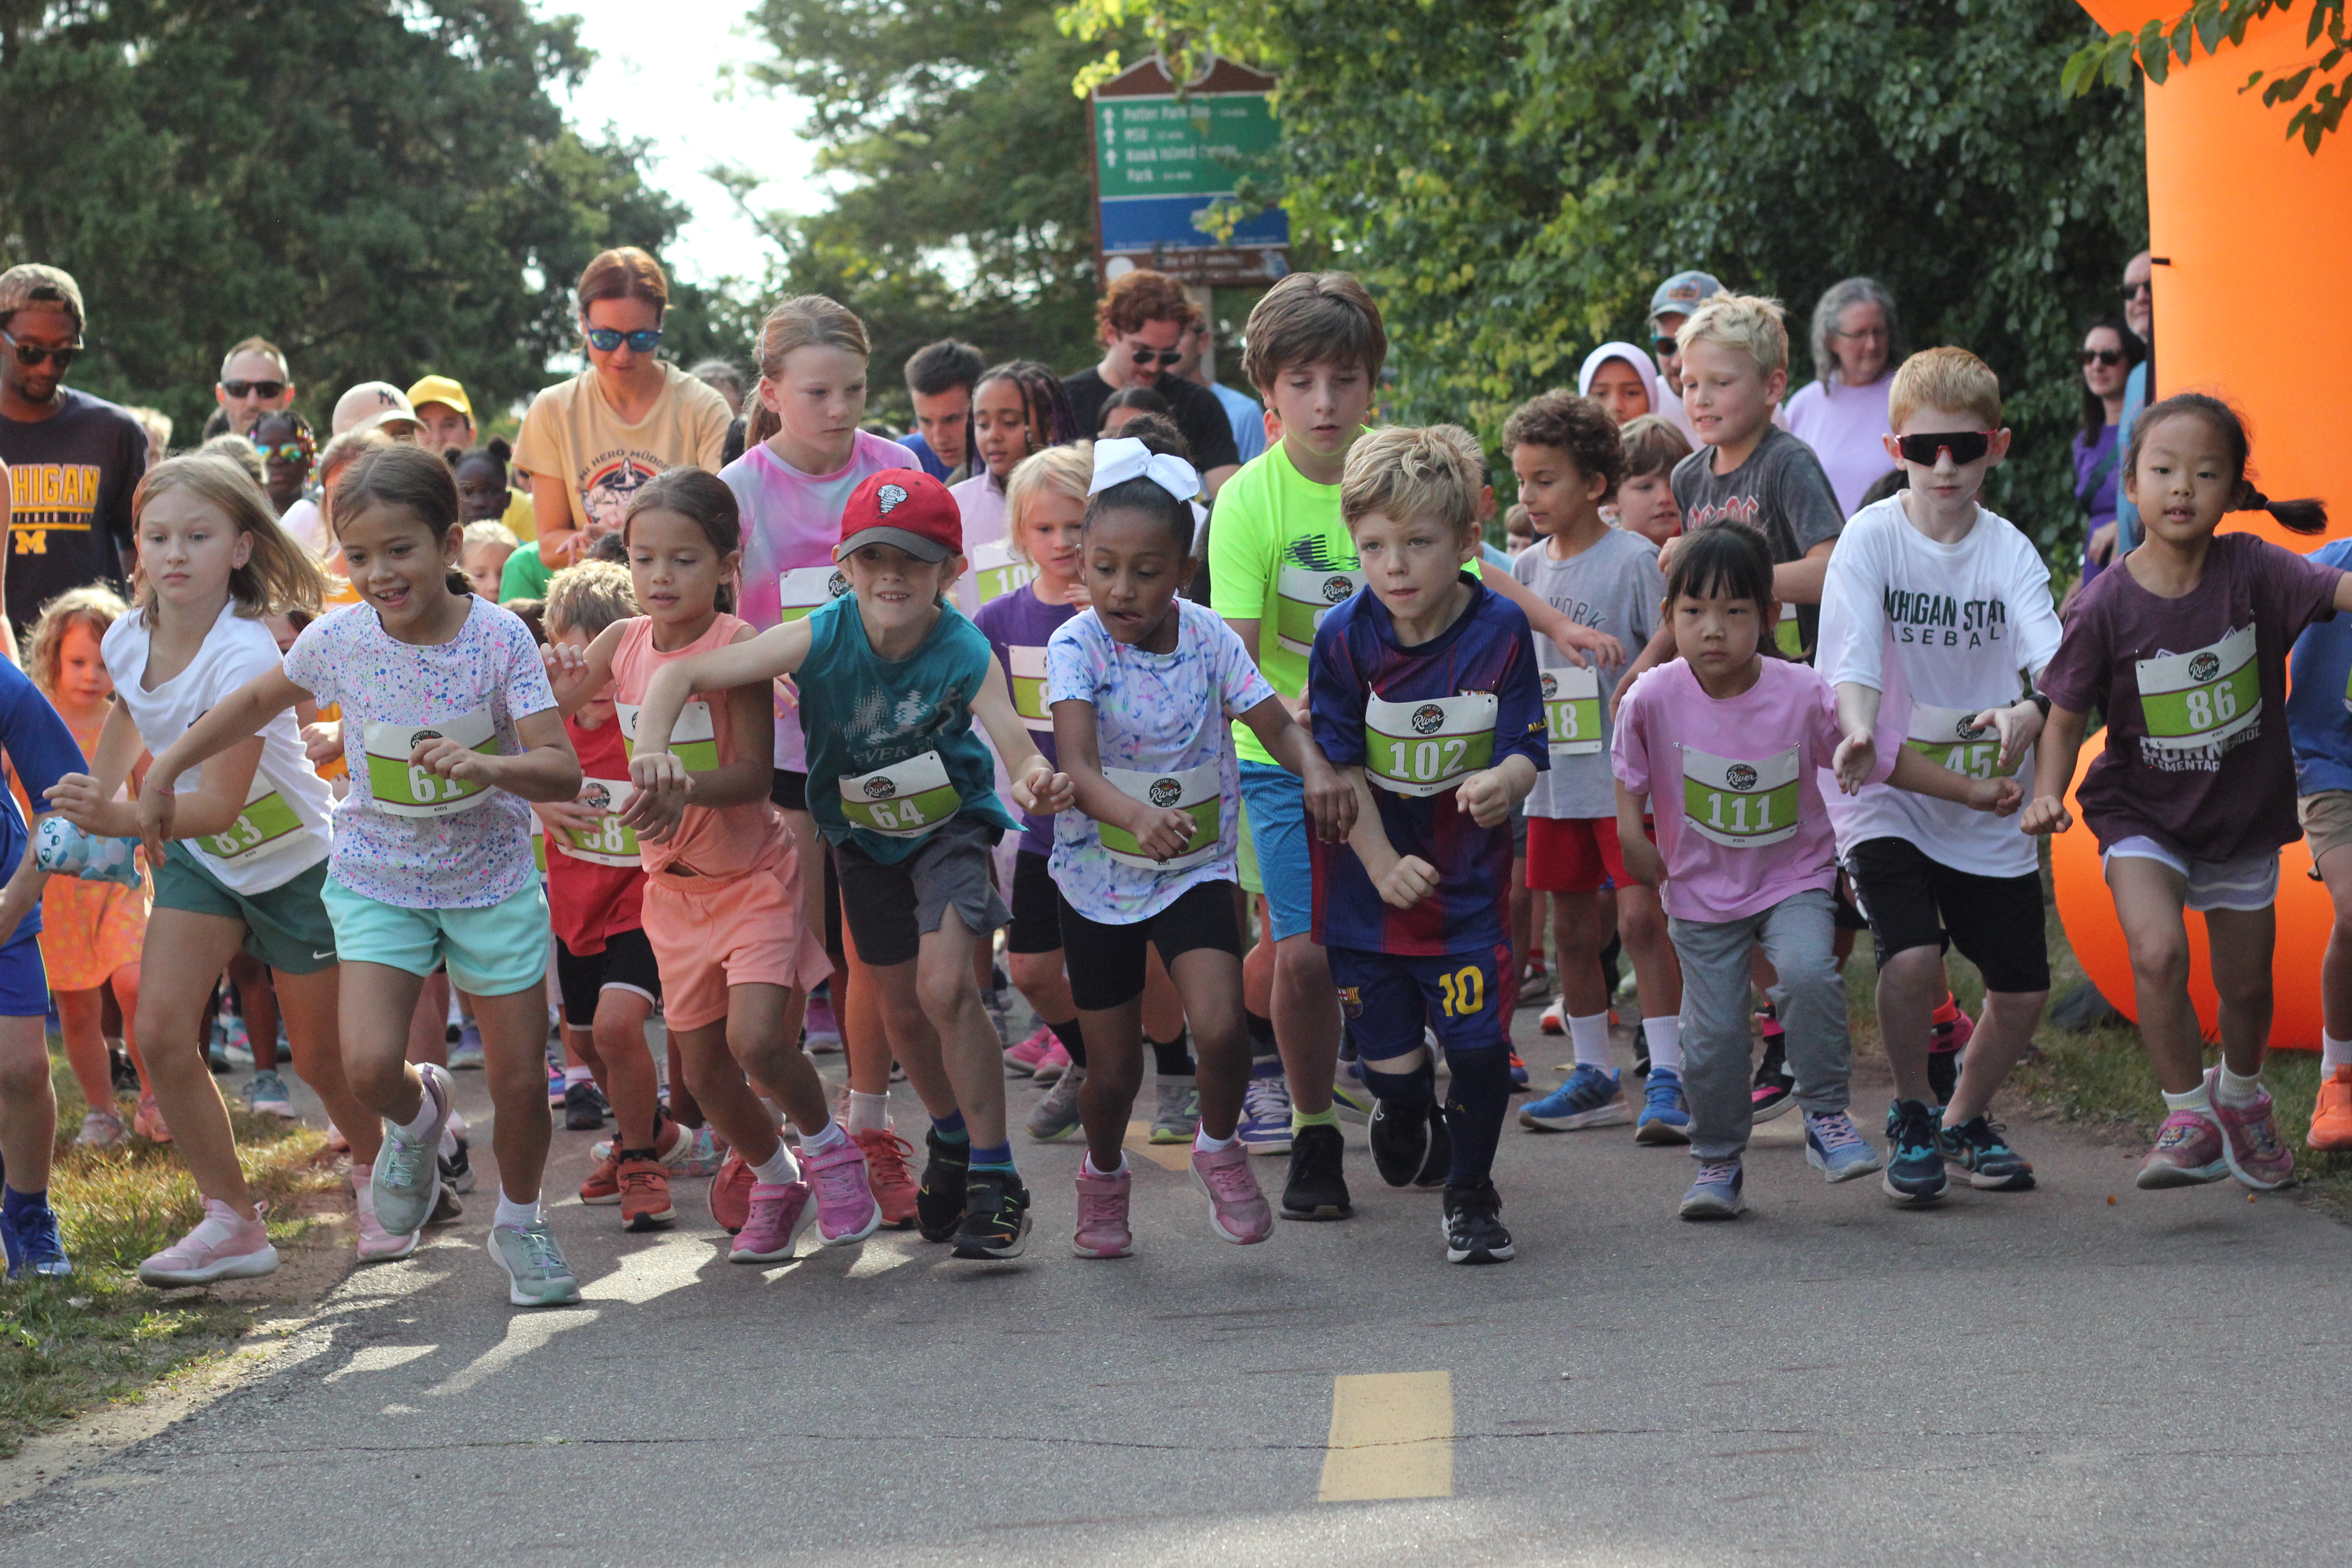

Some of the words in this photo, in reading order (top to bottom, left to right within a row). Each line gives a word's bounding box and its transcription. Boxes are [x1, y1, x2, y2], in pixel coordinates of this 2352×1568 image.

[592, 449, 625, 466] HERO
[15, 530, 47, 555] M
[1322, 584, 1356, 598] River
[1891, 624, 2008, 649] SEBAL
[2190, 659, 2221, 679] River
[1416, 705, 1431, 715] CAPITAL
[2186, 681, 2236, 729] 86
[1411, 714, 1448, 730] River
[1425, 725, 1438, 734] RUN
[1389, 739, 1468, 781] 102
[1945, 745, 1994, 779] 45
[408, 765, 464, 802] 61
[866, 783, 898, 797] River
[1154, 779, 1169, 787] CAPITAL
[1726, 771, 1760, 785] River
[1148, 788, 1185, 802] River
[868, 799, 926, 828] 64
[1708, 792, 1773, 832] 111
[211, 815, 263, 853] 83
[583, 816, 623, 852] 58
[1439, 965, 1484, 1016] 10
